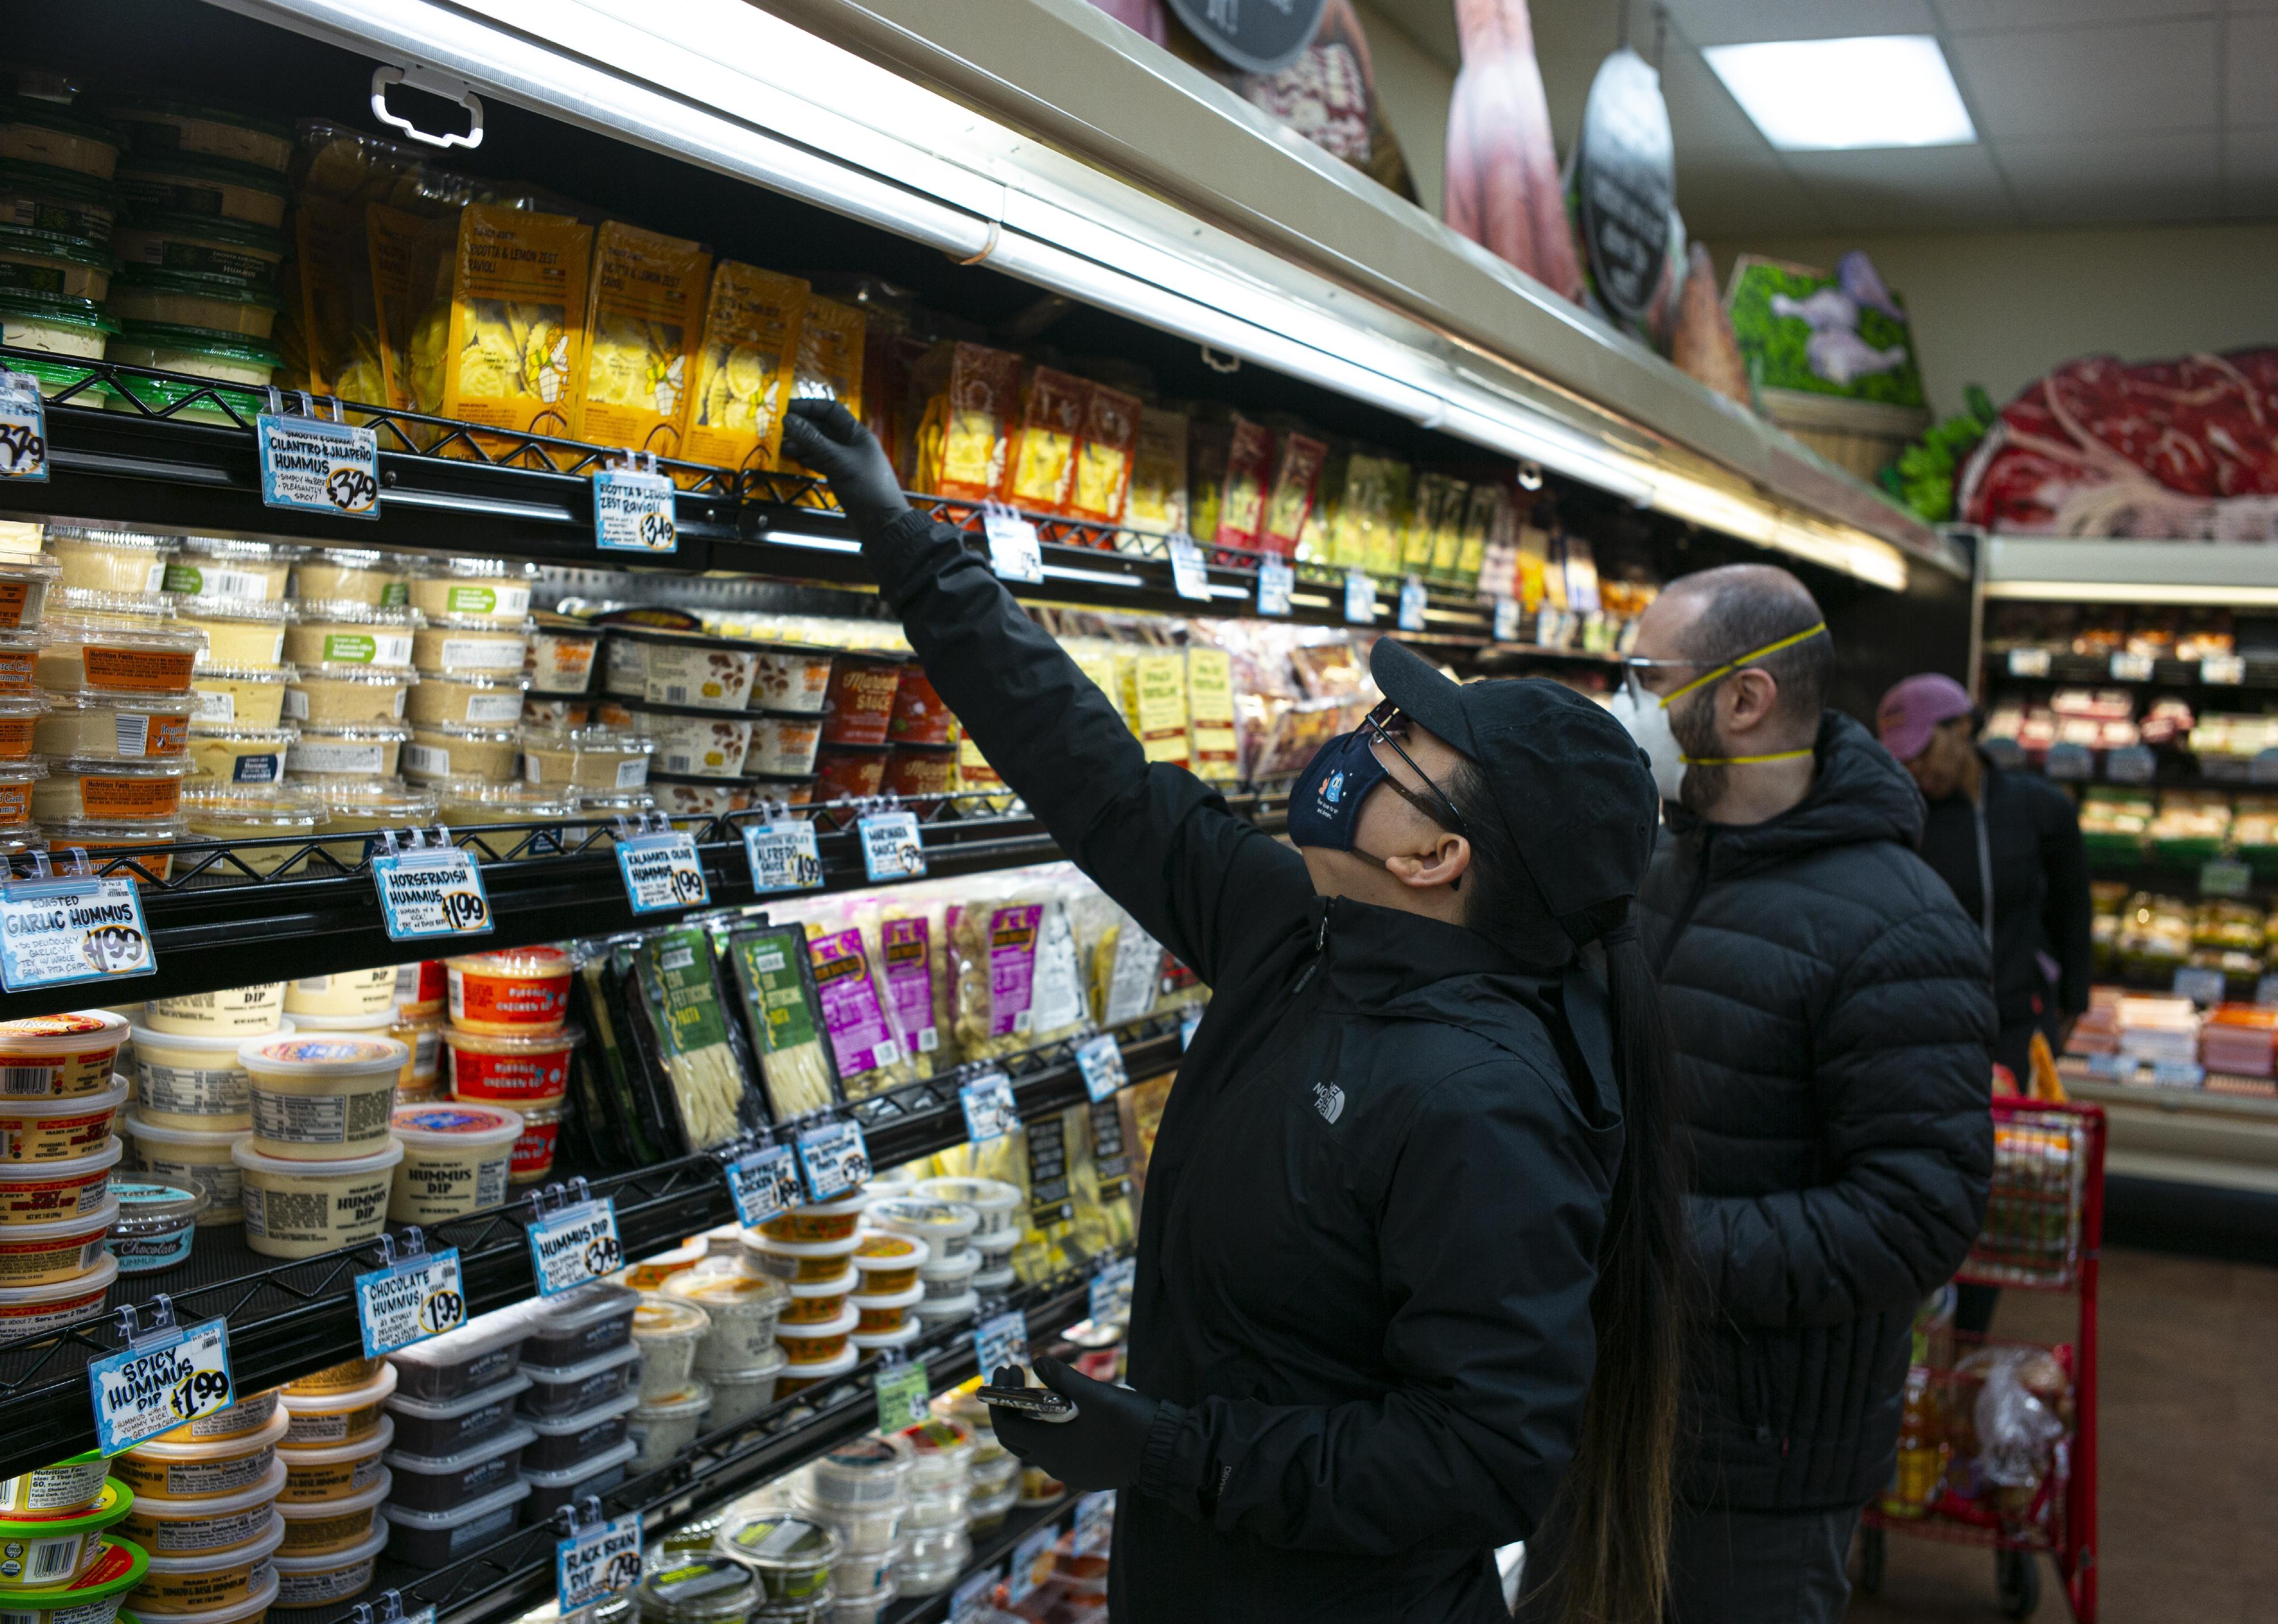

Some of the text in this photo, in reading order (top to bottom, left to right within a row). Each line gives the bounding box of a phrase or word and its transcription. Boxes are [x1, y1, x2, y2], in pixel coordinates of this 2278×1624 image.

[470, 243, 557, 264] RICOTTA & LEMON ZEST
[468, 258, 496, 273] RAVIOLI
[286, 430, 318, 441] SMOOTH
[325, 436, 355, 447] CREAMY
[270, 436, 321, 455] CILANTRO
[329, 445, 372, 461] JALAPEÑO
[275, 453, 330, 475] HUMMUS
[280, 473, 303, 483] SIMPLY
[283, 483, 322, 495] PLEASANTLY
[294, 493, 317, 503] SPICY!
[601, 497, 621, 509] ZEST
[639, 515, 674, 545] $3.49
[6, 792, 25, 803] Garlic
[627, 851, 670, 864] KALAMATA
[757, 846, 798, 861] ALFREDO
[631, 865, 674, 881] HUMMUS
[761, 860, 785, 871] SAUCE
[389, 870, 467, 888] HORSERADISH
[671, 870, 702, 905] $1.99
[30, 896, 79, 909] ROASTED
[389, 889, 443, 905] HUMMUS
[6, 903, 133, 935] GARLIC HUMMUS
[442, 892, 484, 932] $1.99
[33, 936, 79, 949] DELICIOUSLY
[29, 945, 71, 958] GARLIC-Y!
[22, 959, 35, 968] TRY
[51, 954, 75, 964] WHOLE
[22, 961, 91, 977] GRAIN PITA CHIPS!
[244, 991, 266, 1003] DIP
[409, 1169, 472, 1181] HUMMUS
[31, 1190, 62, 1201] SPICY
[82, 1183, 102, 1193] Nutrition
[428, 1182, 452, 1194] DIP
[11, 1197, 76, 1211] HUMMUS DIP
[337, 1190, 386, 1210] HUMMUS
[355, 1206, 375, 1221] DIP
[540, 1218, 608, 1258] HUMMUS DIP
[121, 1239, 177, 1255] Chocolate
[585, 1237, 621, 1274] $3.49
[371, 1270, 430, 1300] CHOCOLATE
[390, 1311, 412, 1323] ACTUALLY
[421, 1292, 462, 1332] $1.99
[123, 1346, 177, 1382] SPICY
[108, 1357, 194, 1410] HUMMUS
[137, 1392, 162, 1411] DIP
[171, 1371, 229, 1419] $1.99
[117, 1413, 145, 1428] HUMMUS
[148, 1406, 162, 1415] with
[122, 1410, 169, 1435] YUMMY KICK!
[133, 1415, 182, 1438] GET PITA CHIPS!
[567, 1543, 601, 1572] BLACK
[210, 1574, 233, 1583] JOE'S
[570, 1565, 595, 1590] DIP
[163, 1588, 188, 1596] TOMATO
[195, 1585, 212, 1595] BASIL
[55, 1599, 107, 1616] Nutrition Facts
